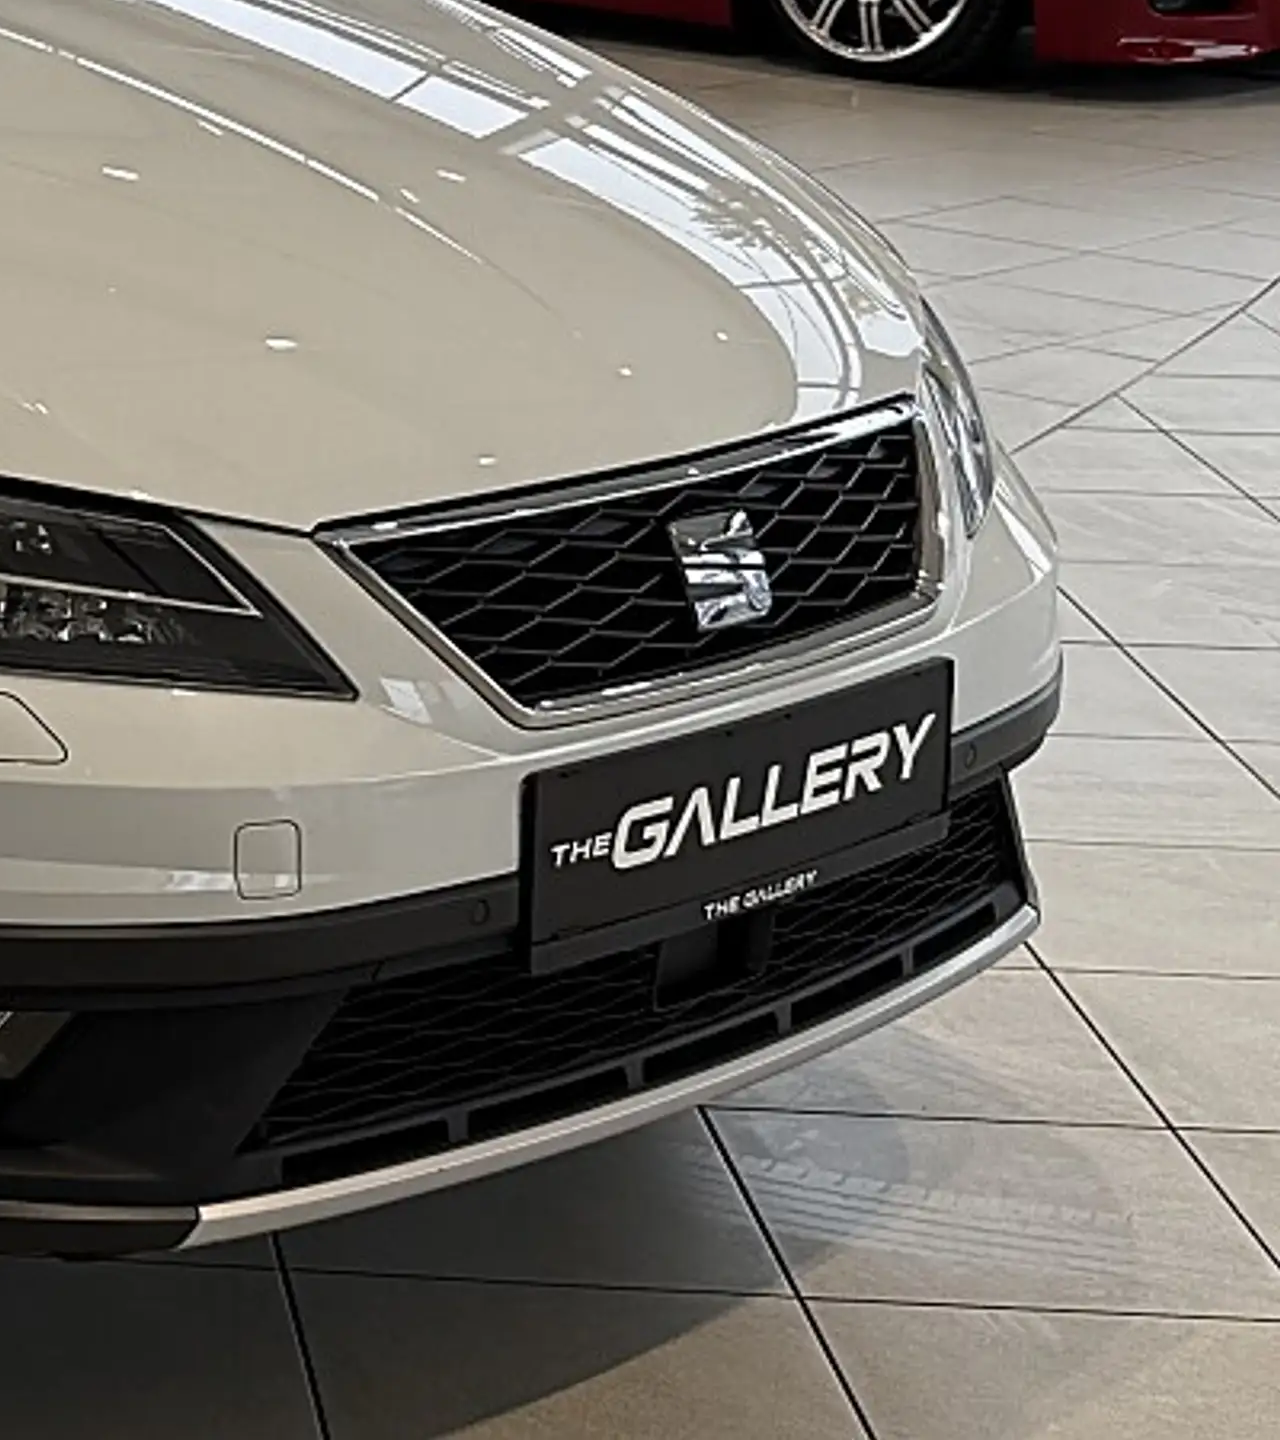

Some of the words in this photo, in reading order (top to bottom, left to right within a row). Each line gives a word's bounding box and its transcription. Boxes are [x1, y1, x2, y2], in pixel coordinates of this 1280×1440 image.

[551, 832, 613, 868] THE
[612, 713, 936, 869] GALLERY
[703, 895, 741, 922] THE
[741, 869, 819, 910] GALLERY
